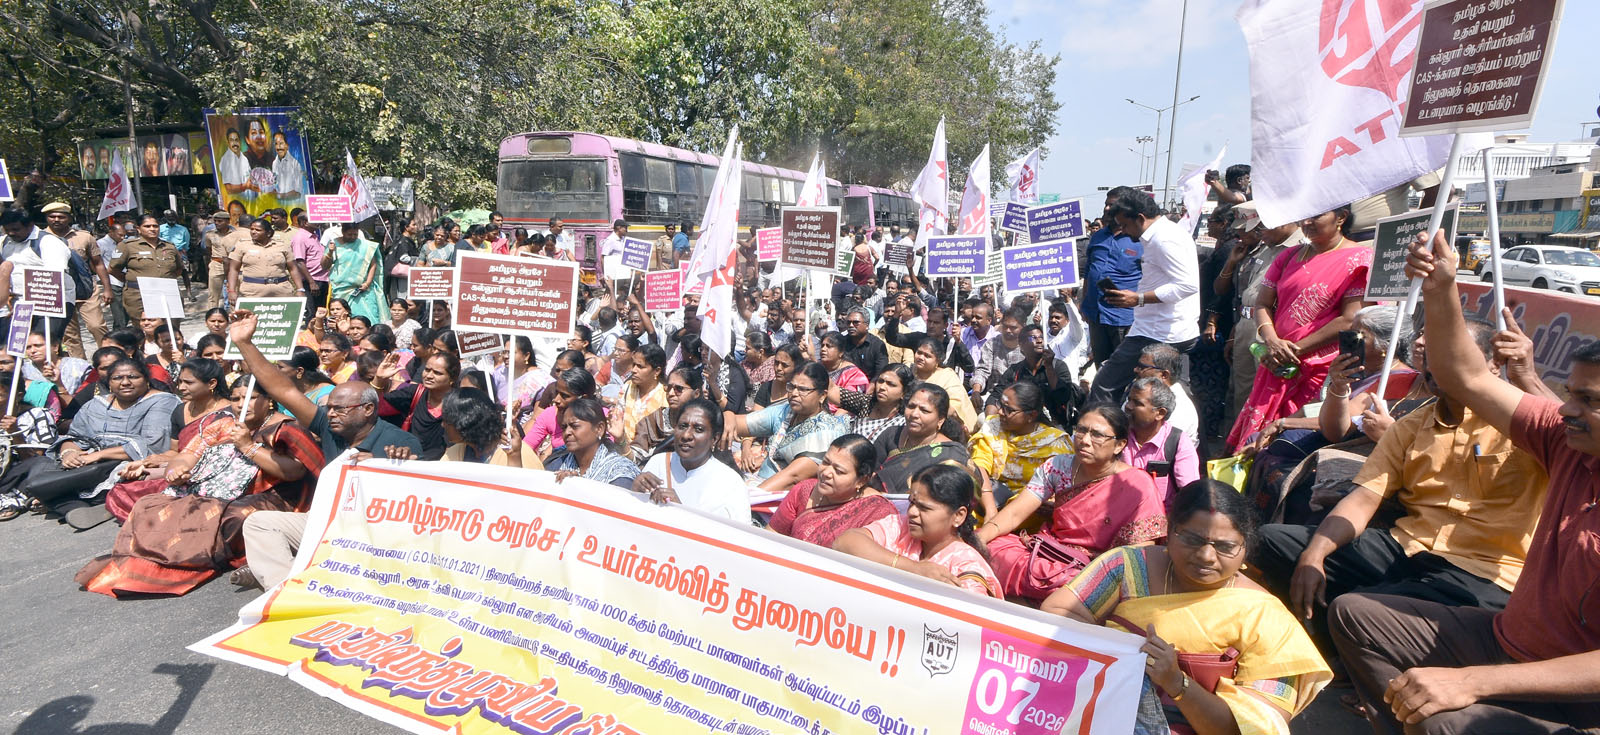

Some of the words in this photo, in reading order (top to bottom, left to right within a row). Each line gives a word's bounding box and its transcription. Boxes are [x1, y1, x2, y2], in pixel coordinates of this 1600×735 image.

[1451, 2, 1487, 25] தமிழக
[1452, 19, 1480, 41] உதவி
[1480, 9, 1516, 34] பெறும்
[1416, 65, 1461, 85] CAS-க்கான
[1461, 54, 1503, 76] ஊதியம்
[1503, 44, 1543, 69] மற்றும்
[1428, 44, 1463, 66] கல்லூரி
[1462, 25, 1536, 58] ஆசிரியர்களின்
[1421, 80, 1462, 105] நிலுவைத்
[1463, 75, 1523, 97] தொகையை
[1418, 103, 1464, 120] உடனடியாக
[366, 495, 484, 542] தமிழ்நாடு
[577, 535, 730, 615] உயர்கல்வித்
[731, 586, 877, 661] துறையே
[319, 558, 361, 576] அரசுக்
[574, 627, 629, 657] அமைப்புச்
[628, 647, 690, 683] சட்டத்திற்கு
[691, 672, 742, 701] மாறான
[307, 579, 319, 592] 5
[540, 643, 608, 684] ஊதியத்தை
[606, 672, 664, 706] நிலுவைத்
[662, 695, 738, 733] தொகையுடன்
[600, 603, 628, 623] 1000
[658, 623, 704, 652] மேற்பட்ட
[706, 643, 784, 683] மாணவர்கள்
[784, 672, 862, 716] ஆய்வுப்பட்டம்
[927, 641, 954, 661] AUT
[984, 640, 1069, 684] பிப்ரவரி
[975, 668, 1041, 725] 07
[1023, 705, 1065, 732] 2026
